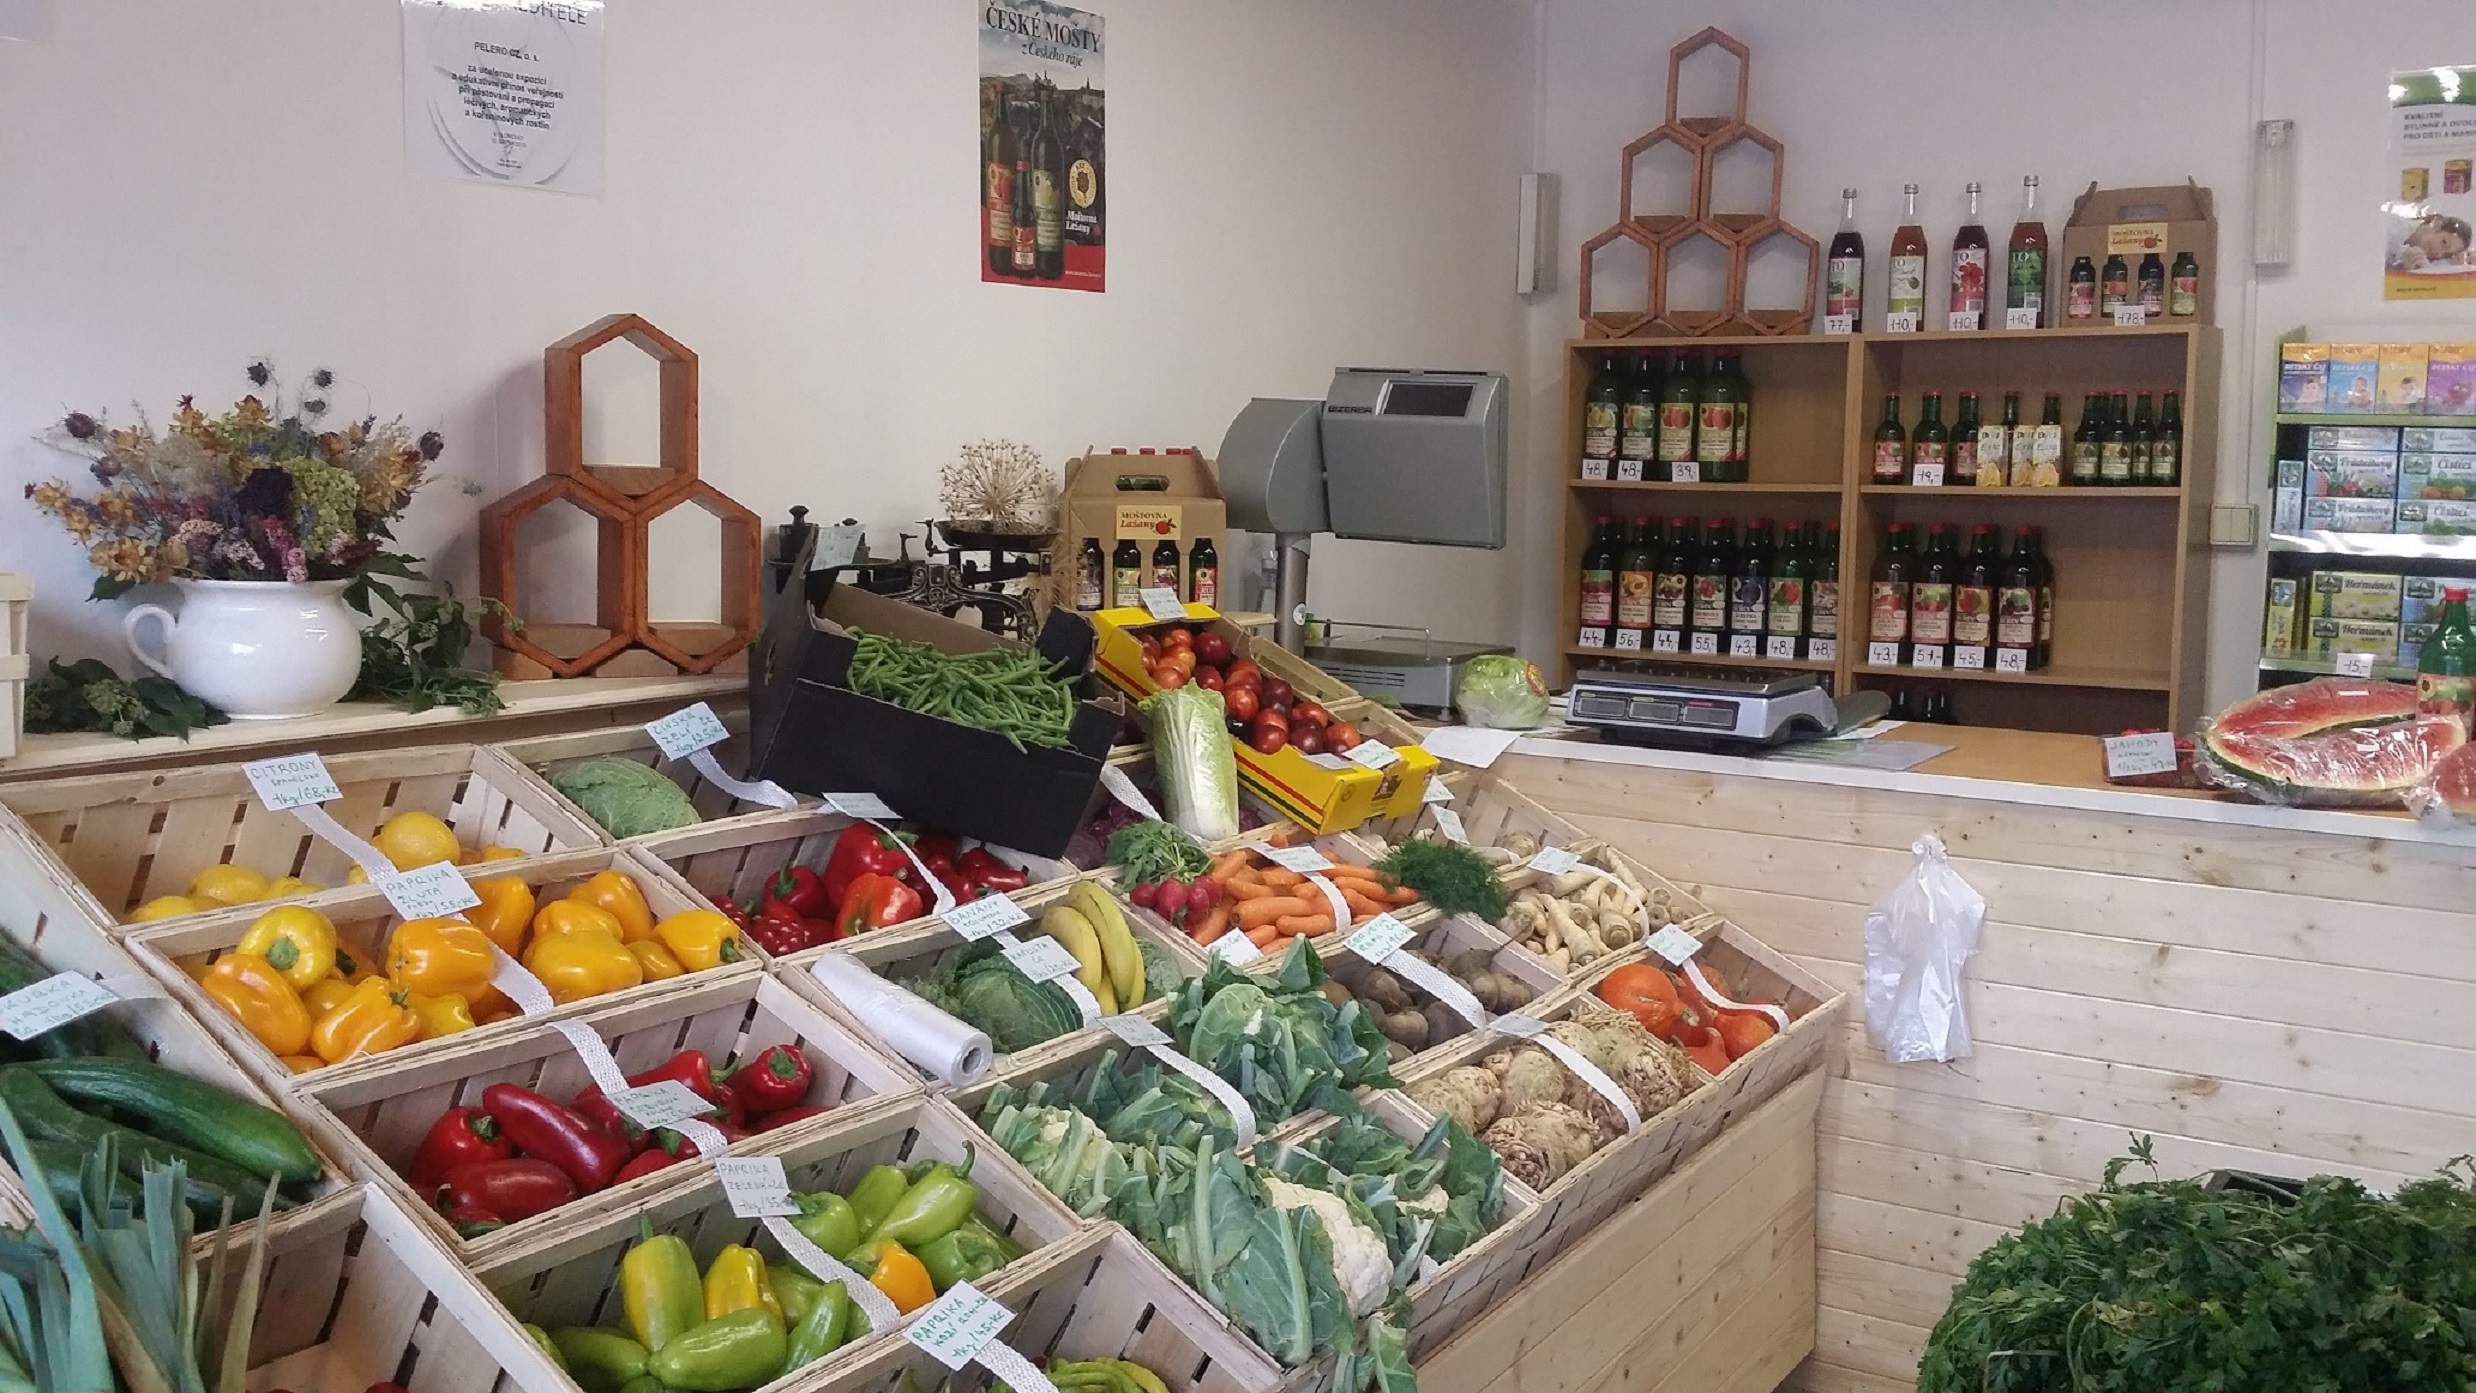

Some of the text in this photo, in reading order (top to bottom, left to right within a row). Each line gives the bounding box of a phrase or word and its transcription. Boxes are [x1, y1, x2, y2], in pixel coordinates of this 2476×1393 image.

[986, 0, 1101, 53] ČESKÉ MOŠTY
[1028, 38, 1064, 62] Českého
[1066, 50, 1083, 69] ráje
[516, 73, 547, 85] expozici
[518, 96, 555, 109] propagaci
[1829, 318, 1850, 333] 77,-
[2118, 313, 2145, 326] 178,-
[1621, 463, 1640, 479] 48,-
[1121, 509, 1168, 519] MOŠTOVNA
[1583, 631, 1603, 646] 44,-
[1619, 633, 1640, 648] 56,-
[1658, 633, 1679, 649] 44,-
[1695, 636, 1715, 653] 55,-
[1735, 639, 1756, 656] 43,-
[1771, 640, 1793, 656] 48,-
[1813, 642, 1835, 658] 48,-
[1873, 647, 1896, 662] 43,-
[1959, 653, 1982, 667] 45,-
[2001, 654, 2025, 671] 48,-
[250, 760, 317, 780] CITRONY
[385, 869, 453, 894] PAPRIKA
[947, 900, 1000, 925] BANÁNY
[719, 1162, 770, 1176] PAPRIKA
[912, 1298, 966, 1342] PAPRIKA
